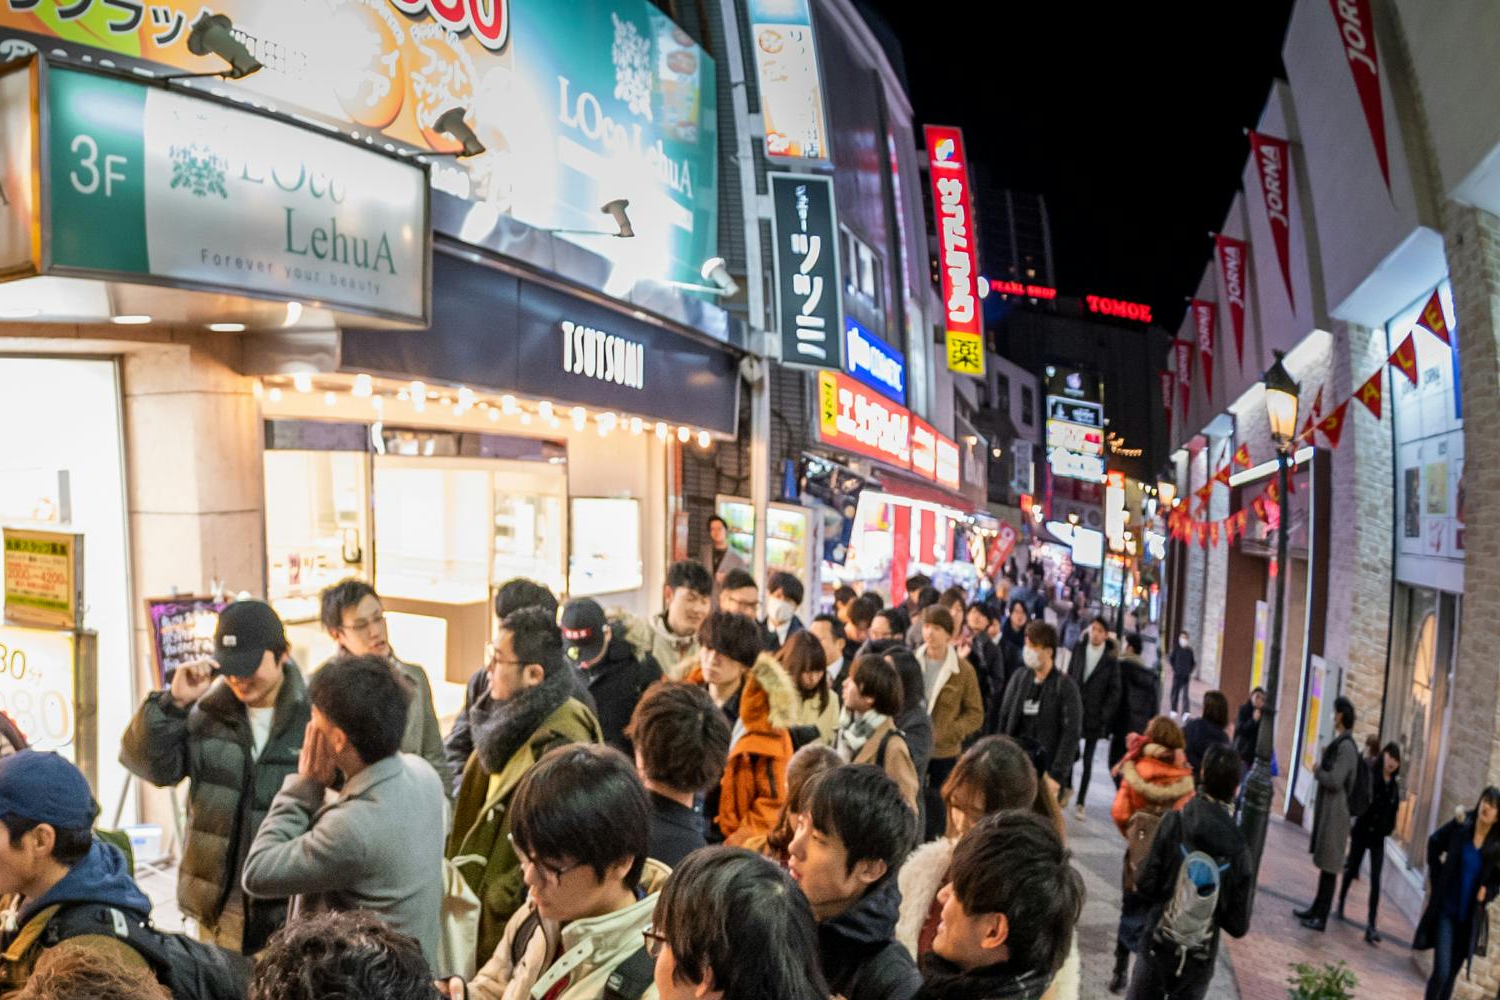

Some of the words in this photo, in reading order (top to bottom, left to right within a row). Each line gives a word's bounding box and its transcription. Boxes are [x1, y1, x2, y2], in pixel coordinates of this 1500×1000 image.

[69, 134, 128, 198] 3F
[1259, 144, 1288, 227] JORNA
[201, 249, 274, 273] Forever
[285, 265, 321, 283] your
[330, 274, 382, 295] beauty
[284, 206, 398, 276] LehuA
[790, 233, 828, 361] ツツミ
[1086, 294, 1152, 323] TOMOE
[1223, 246, 1244, 308] JORNA
[562, 321, 644, 390] TSUTSUMI
[1197, 306, 1212, 355] JORNA
